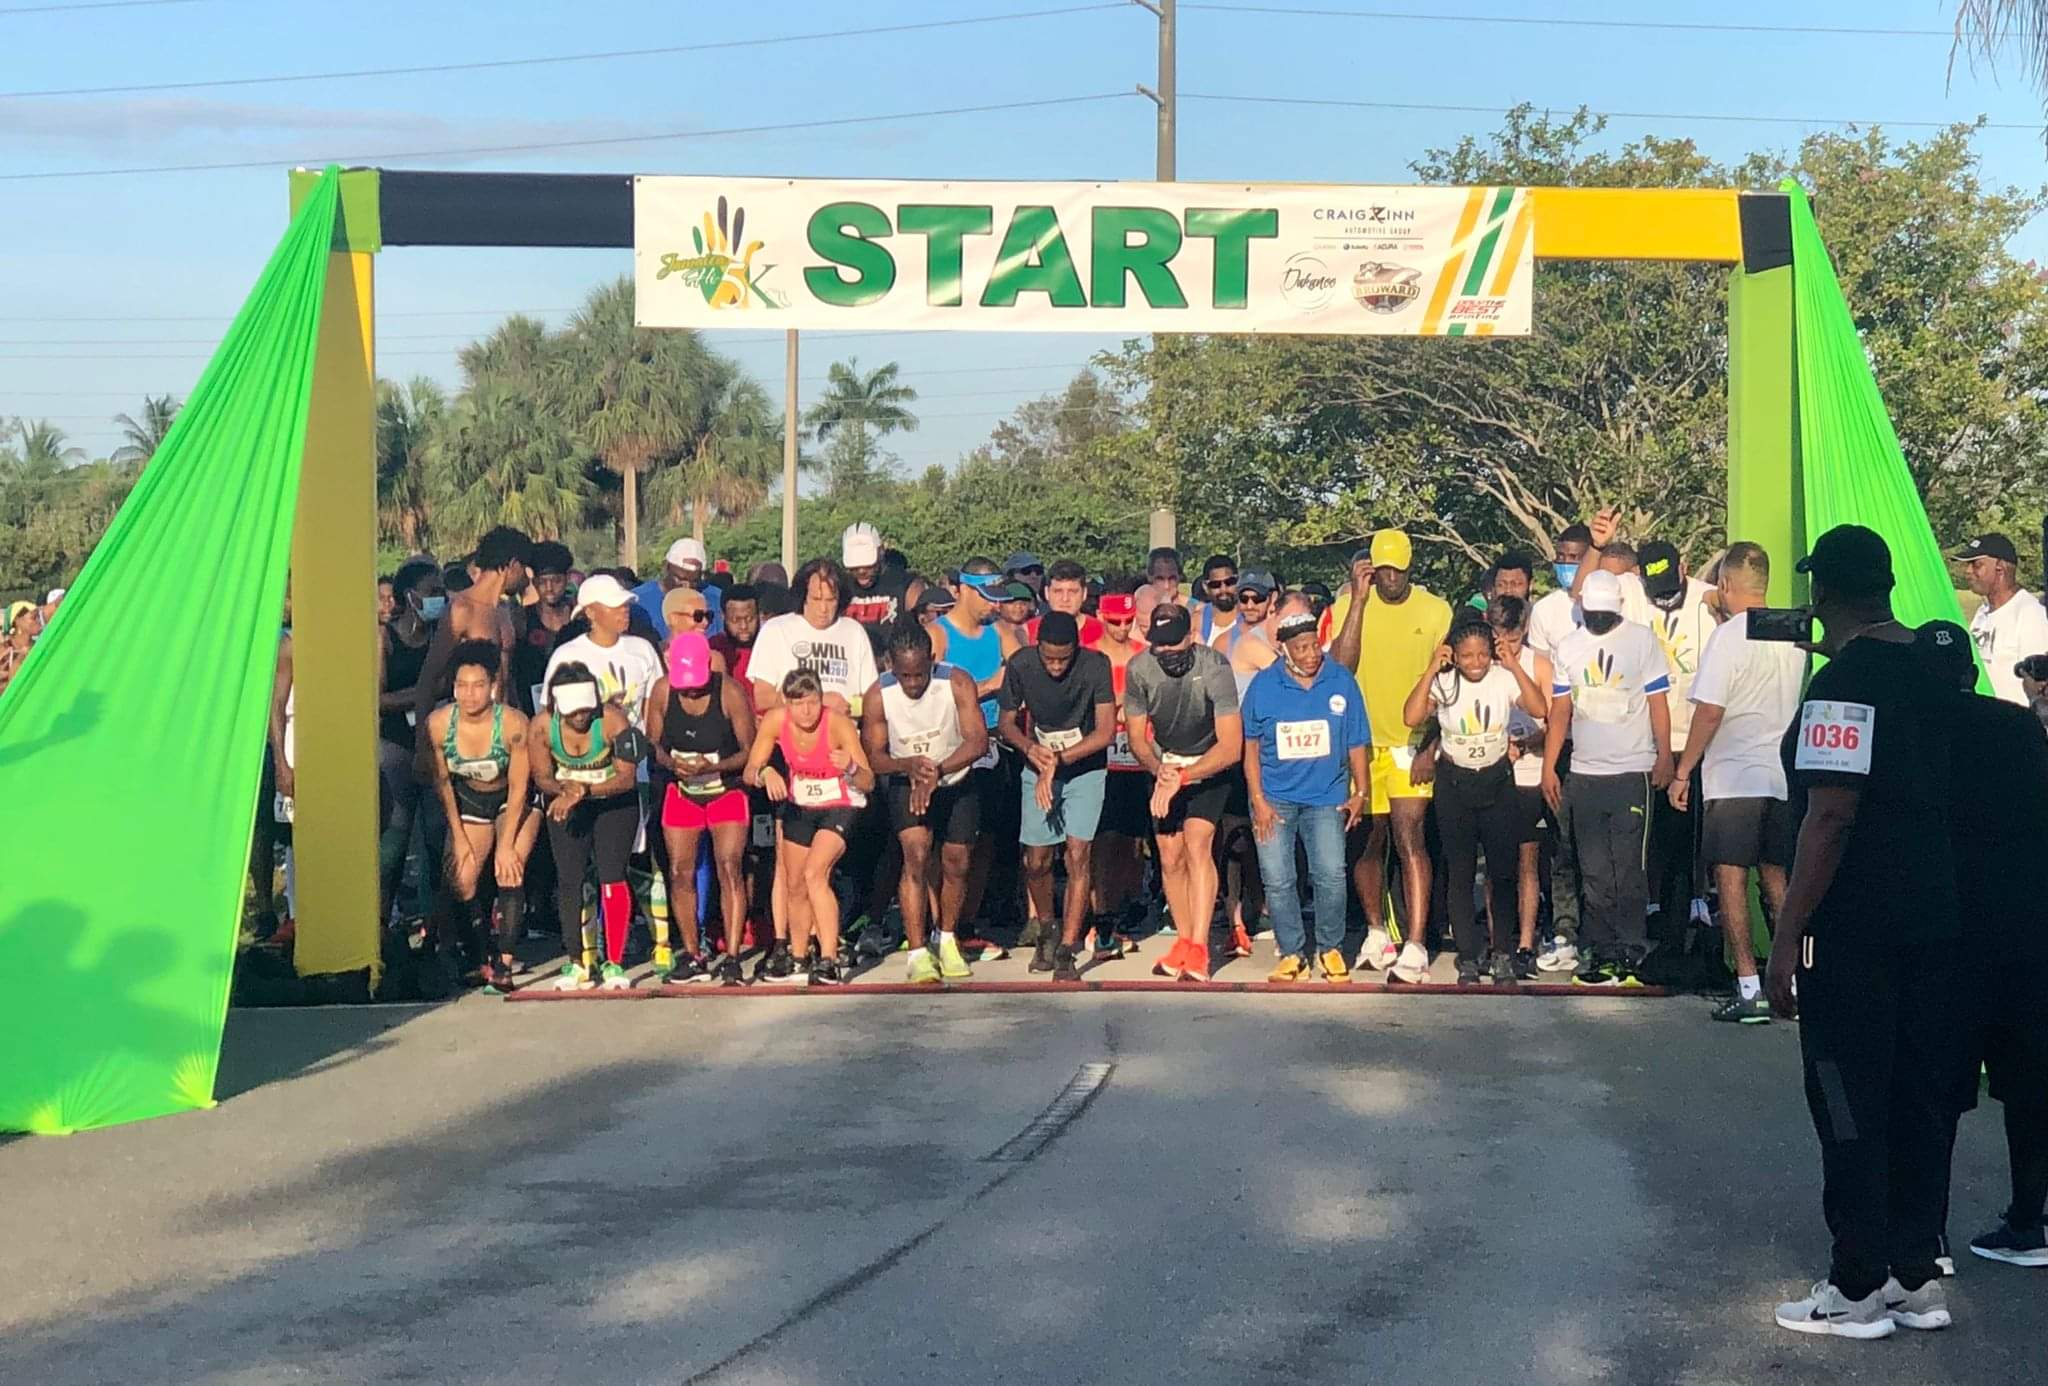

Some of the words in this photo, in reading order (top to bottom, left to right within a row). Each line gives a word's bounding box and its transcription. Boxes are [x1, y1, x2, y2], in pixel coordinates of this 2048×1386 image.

[1313, 208, 1366, 220] CRAIG
[803, 200, 1278, 309] START
[1356, 284, 1417, 297] BROWARD
[811, 642, 848, 661] WILL
[1286, 734, 1320, 747] 1127
[1804, 723, 1859, 750] 1036
[913, 742, 930, 753] 57
[1468, 746, 1486, 759] 23
[806, 784, 823, 797] 25
